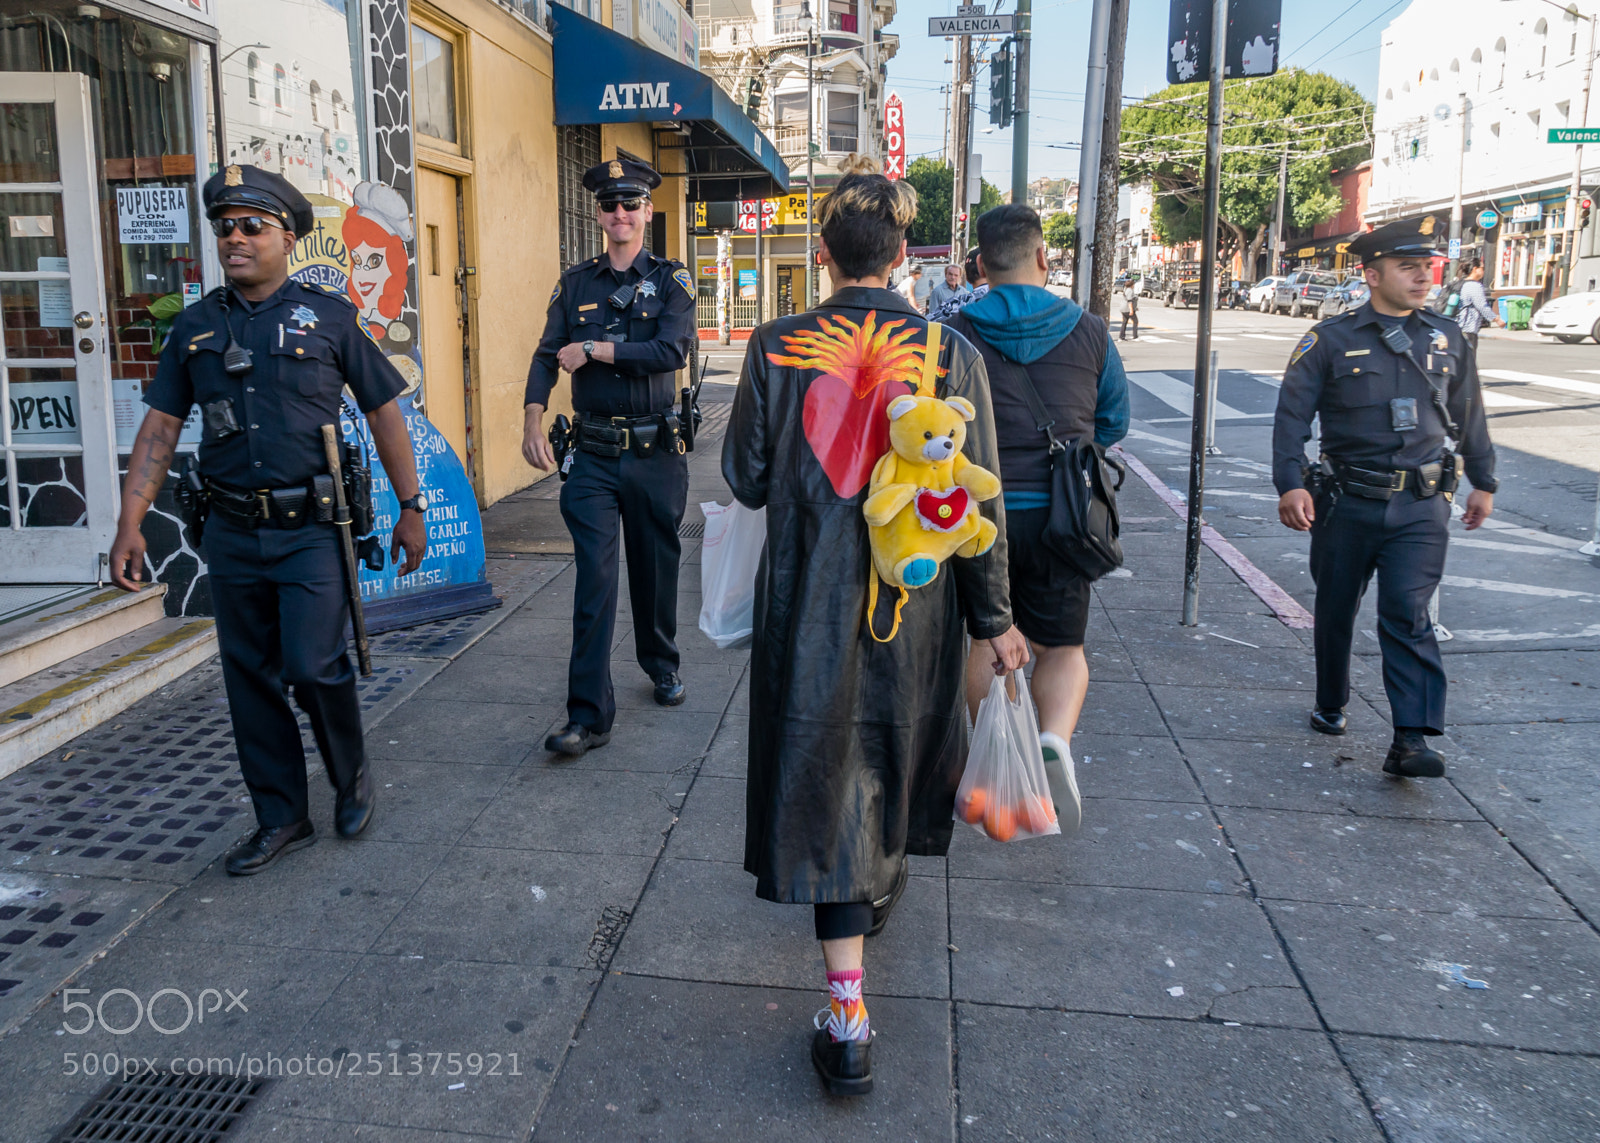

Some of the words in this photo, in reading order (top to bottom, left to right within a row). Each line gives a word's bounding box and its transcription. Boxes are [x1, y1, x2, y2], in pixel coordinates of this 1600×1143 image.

[967, 6, 983, 16] 500
[940, 19, 1000, 32] VALENCIA
[599, 82, 670, 110] ATM
[118, 189, 185, 216] PUPUSERA
